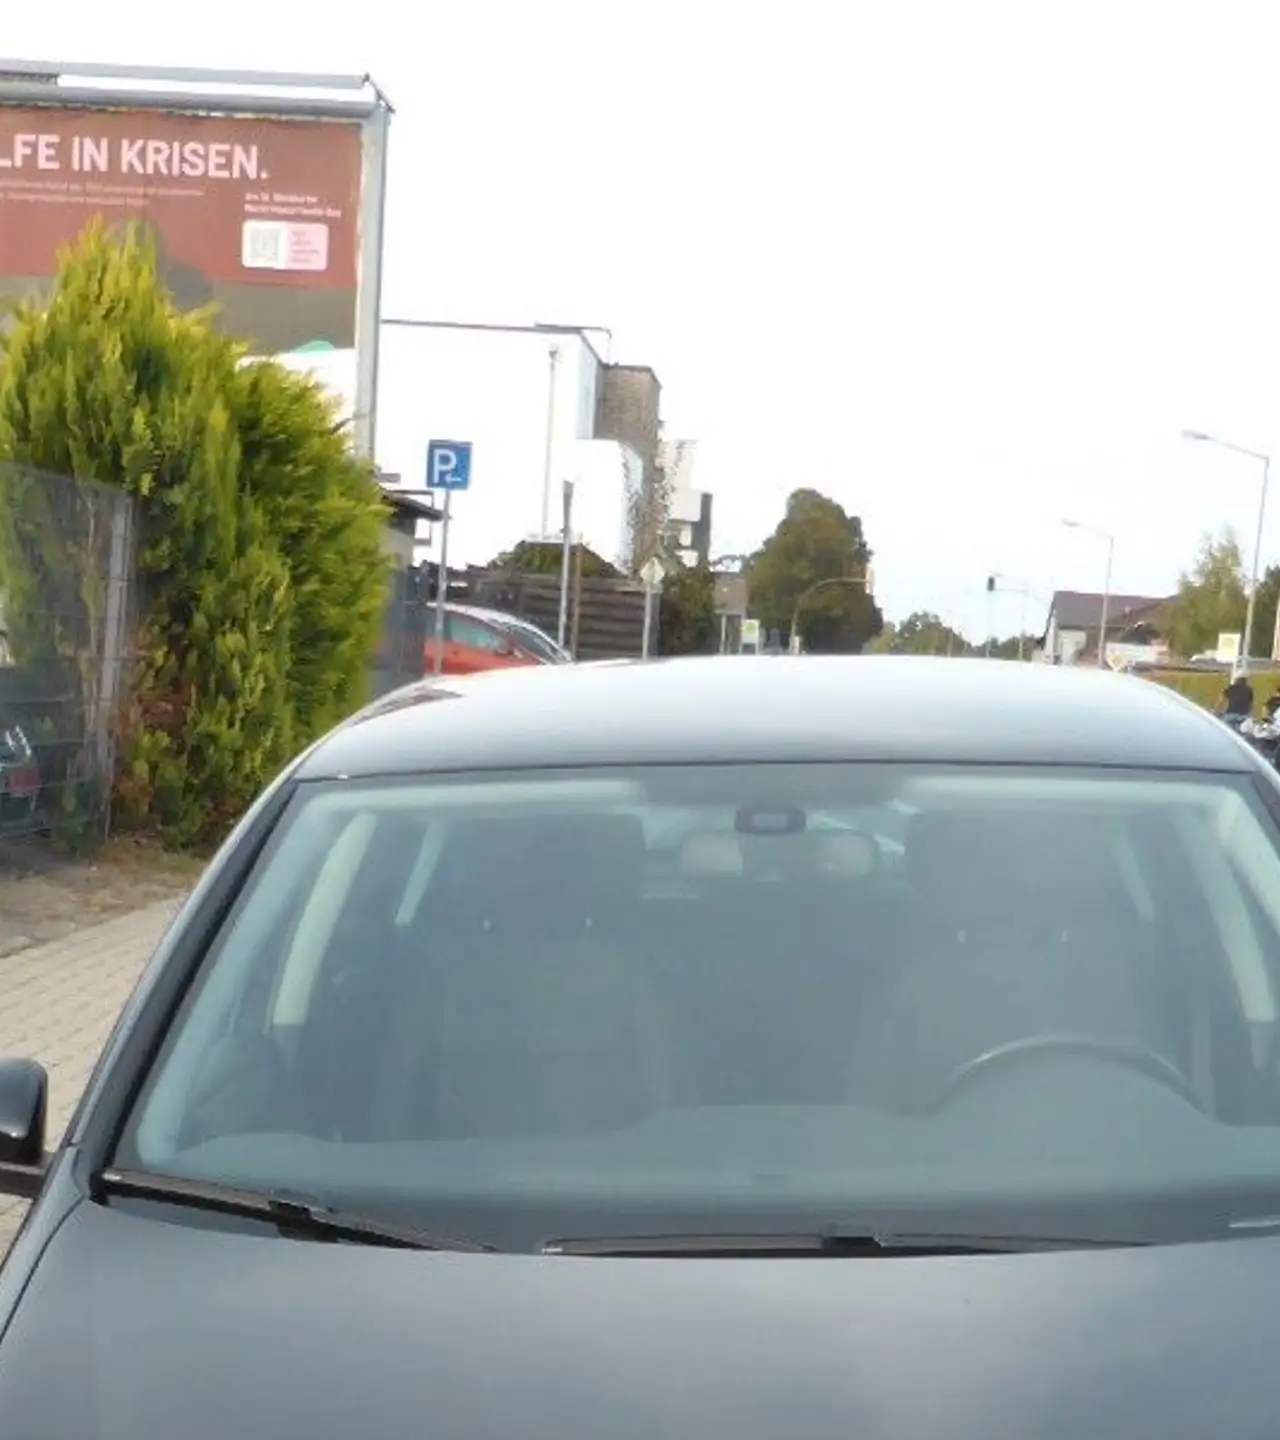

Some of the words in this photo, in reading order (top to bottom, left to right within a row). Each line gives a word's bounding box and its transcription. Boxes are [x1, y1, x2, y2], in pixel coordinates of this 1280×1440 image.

[72, 137, 108, 172] IN
[121, 139, 269, 180] KRISEN.
[433, 449, 457, 484] P
